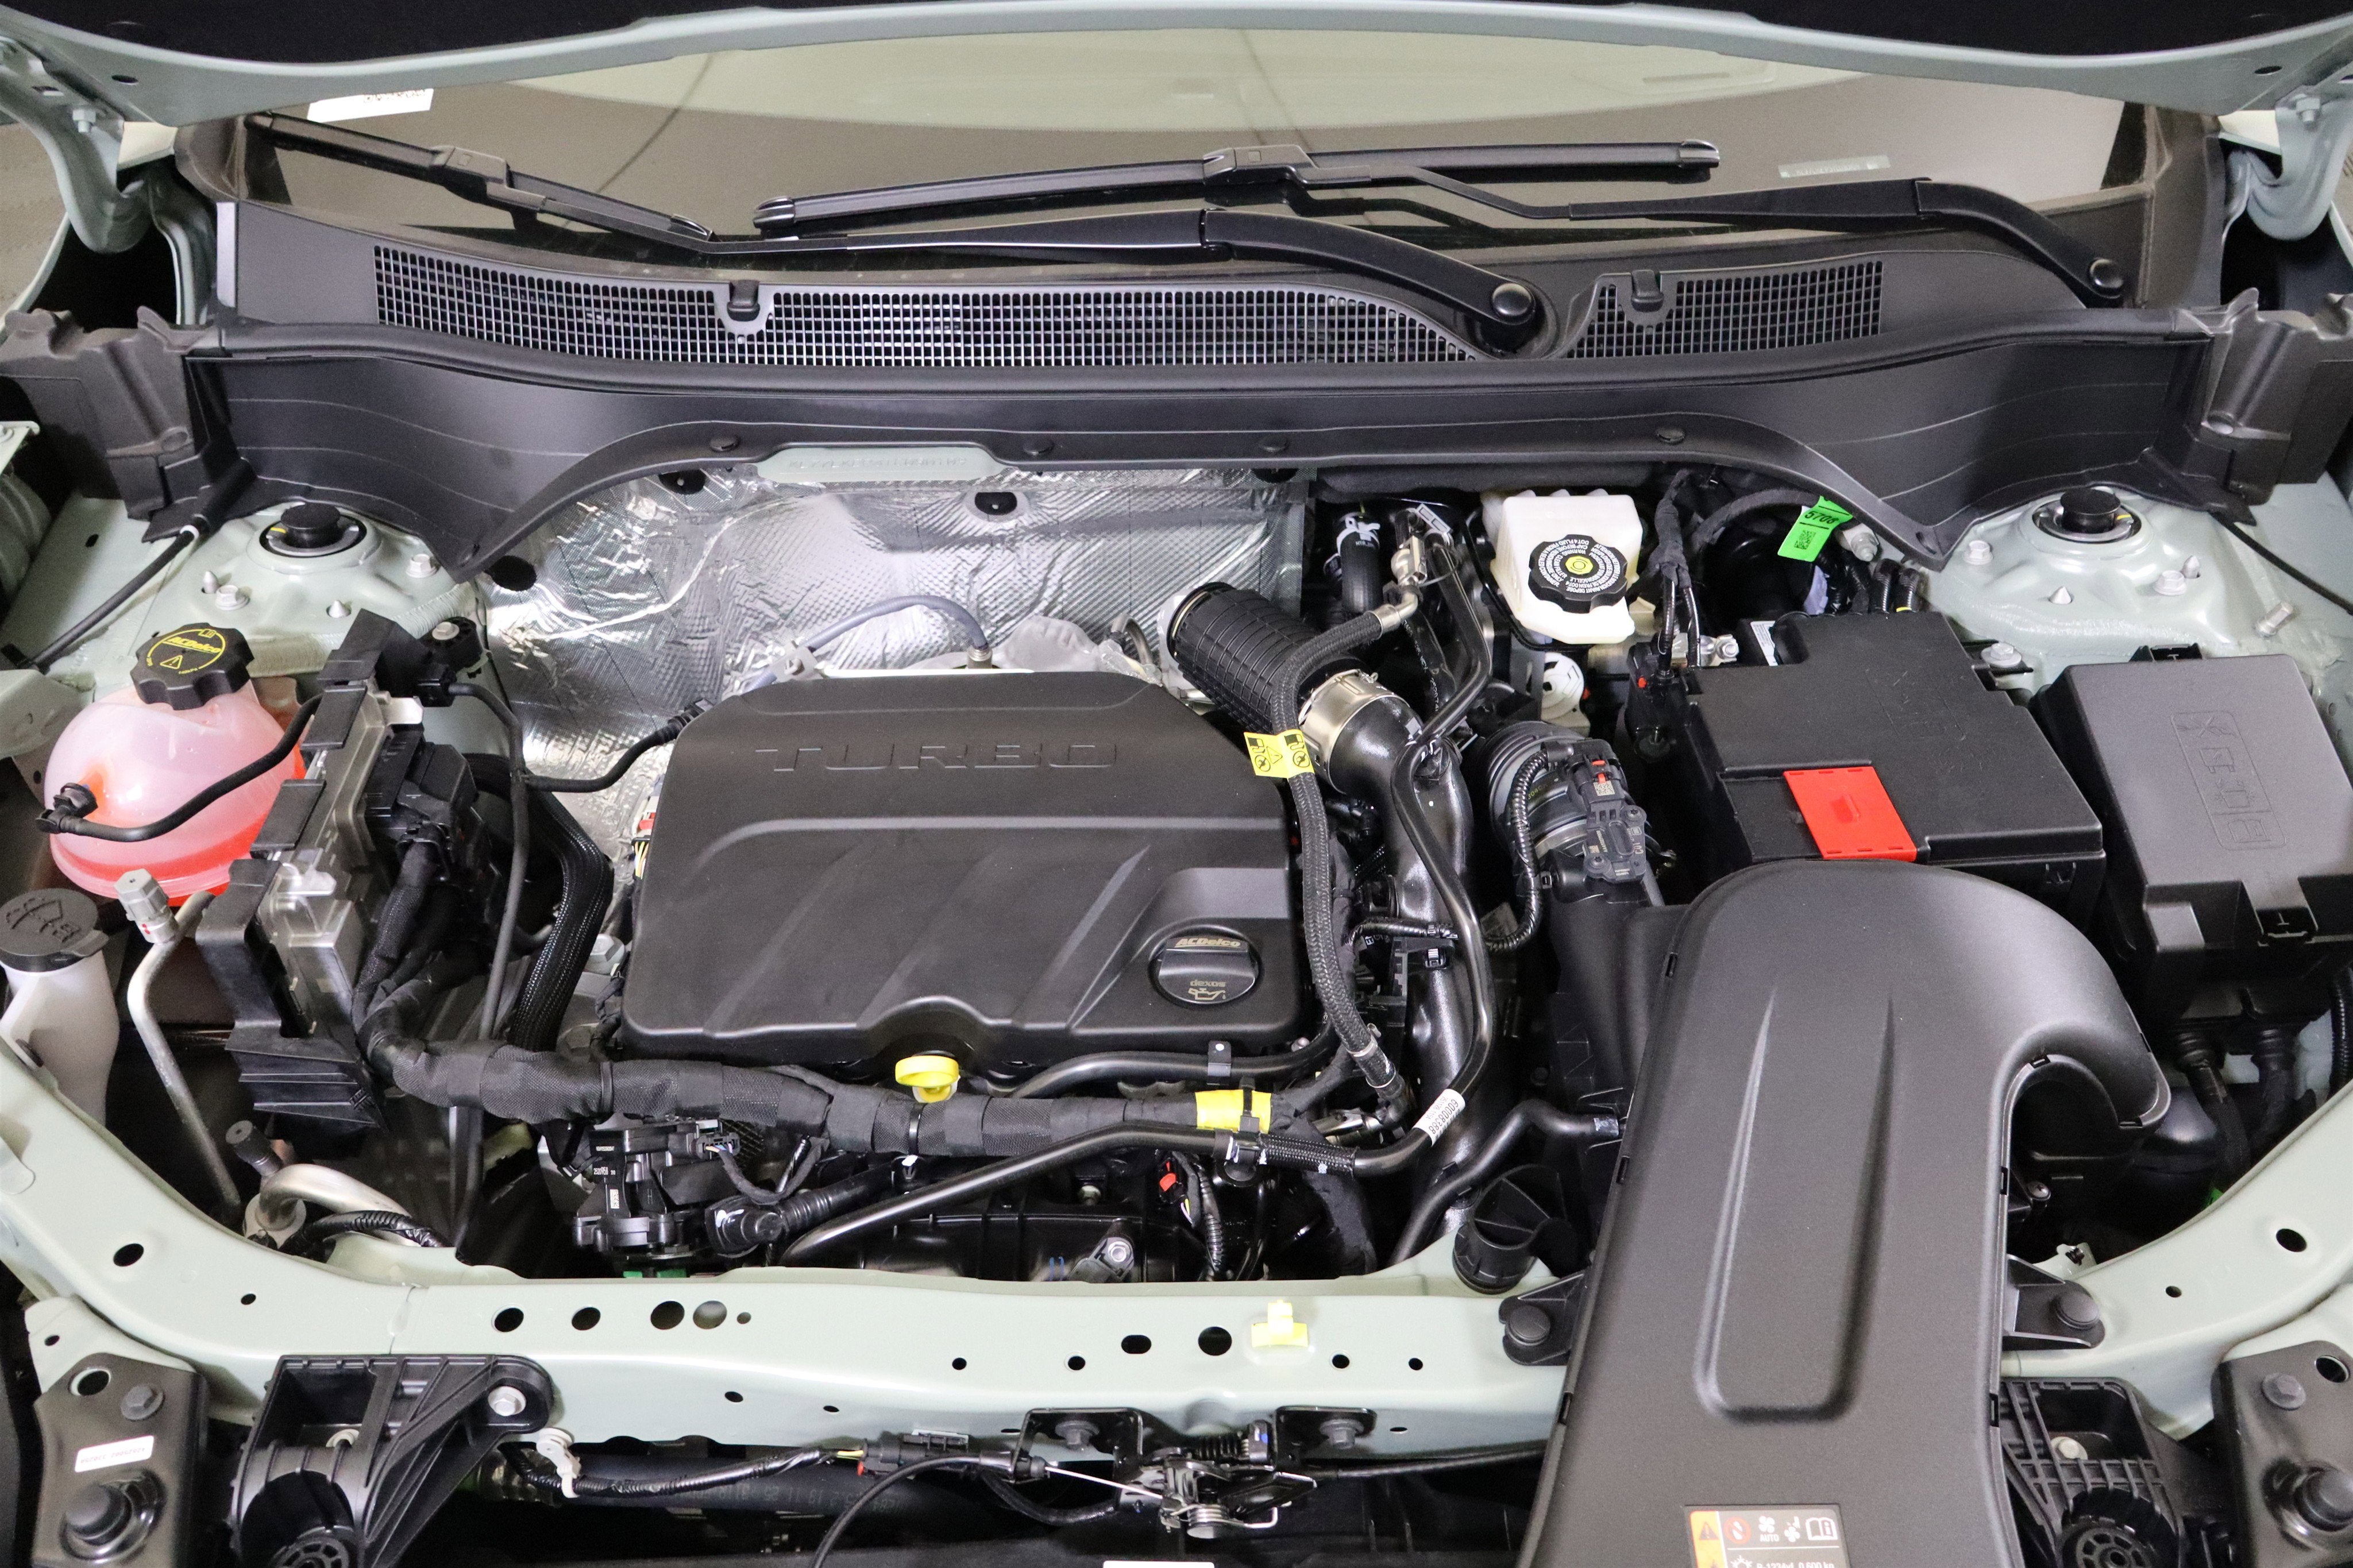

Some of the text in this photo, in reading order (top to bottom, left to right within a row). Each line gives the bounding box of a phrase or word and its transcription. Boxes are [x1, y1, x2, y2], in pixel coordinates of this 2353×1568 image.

[1545, 542, 1560, 552] FROM
[1556, 544, 1576, 552] BEFORE
[1538, 552, 1548, 566] SEALED
[1554, 554, 1564, 566] CLEAN
[1539, 566, 1561, 587] CONTAINER.
[1550, 572, 1564, 582] ONLY
[1554, 566, 1568, 578] FILLER
[1587, 574, 1600, 582] BIDON
[1595, 573, 1610, 584] LIQUIDE
[1598, 577, 1617, 590] BOUCHON
[167, 636, 222, 654] ACDelco
[755, 743, 1117, 771] TURBO
[1175, 938, 1241, 947] ACDelco
[1190, 979, 1226, 987] dexos
[1428, 1098, 1460, 1135] 60008388
[1760, 1534, 1780, 1542] AUTO
